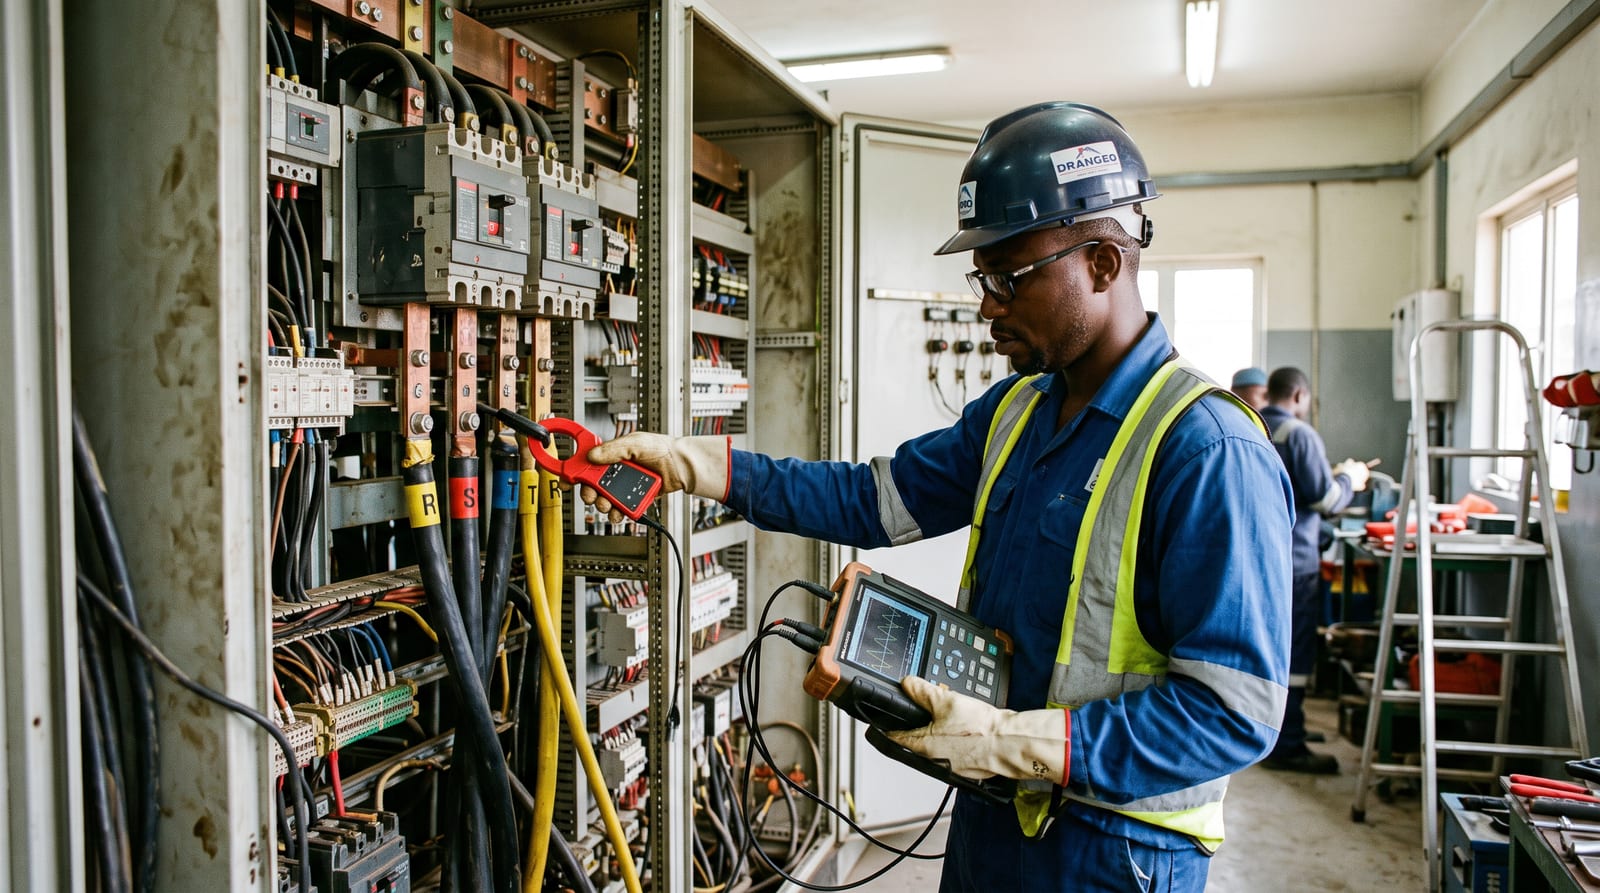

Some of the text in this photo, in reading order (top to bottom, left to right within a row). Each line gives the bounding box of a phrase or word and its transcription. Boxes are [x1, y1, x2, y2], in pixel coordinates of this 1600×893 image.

[1057, 154, 1117, 173] DRANGEO
[464, 488, 475, 508] S
[508, 481, 517, 502] T
[528, 485, 537, 505] T
[549, 479, 561, 499] R
[422, 493, 436, 516] R
